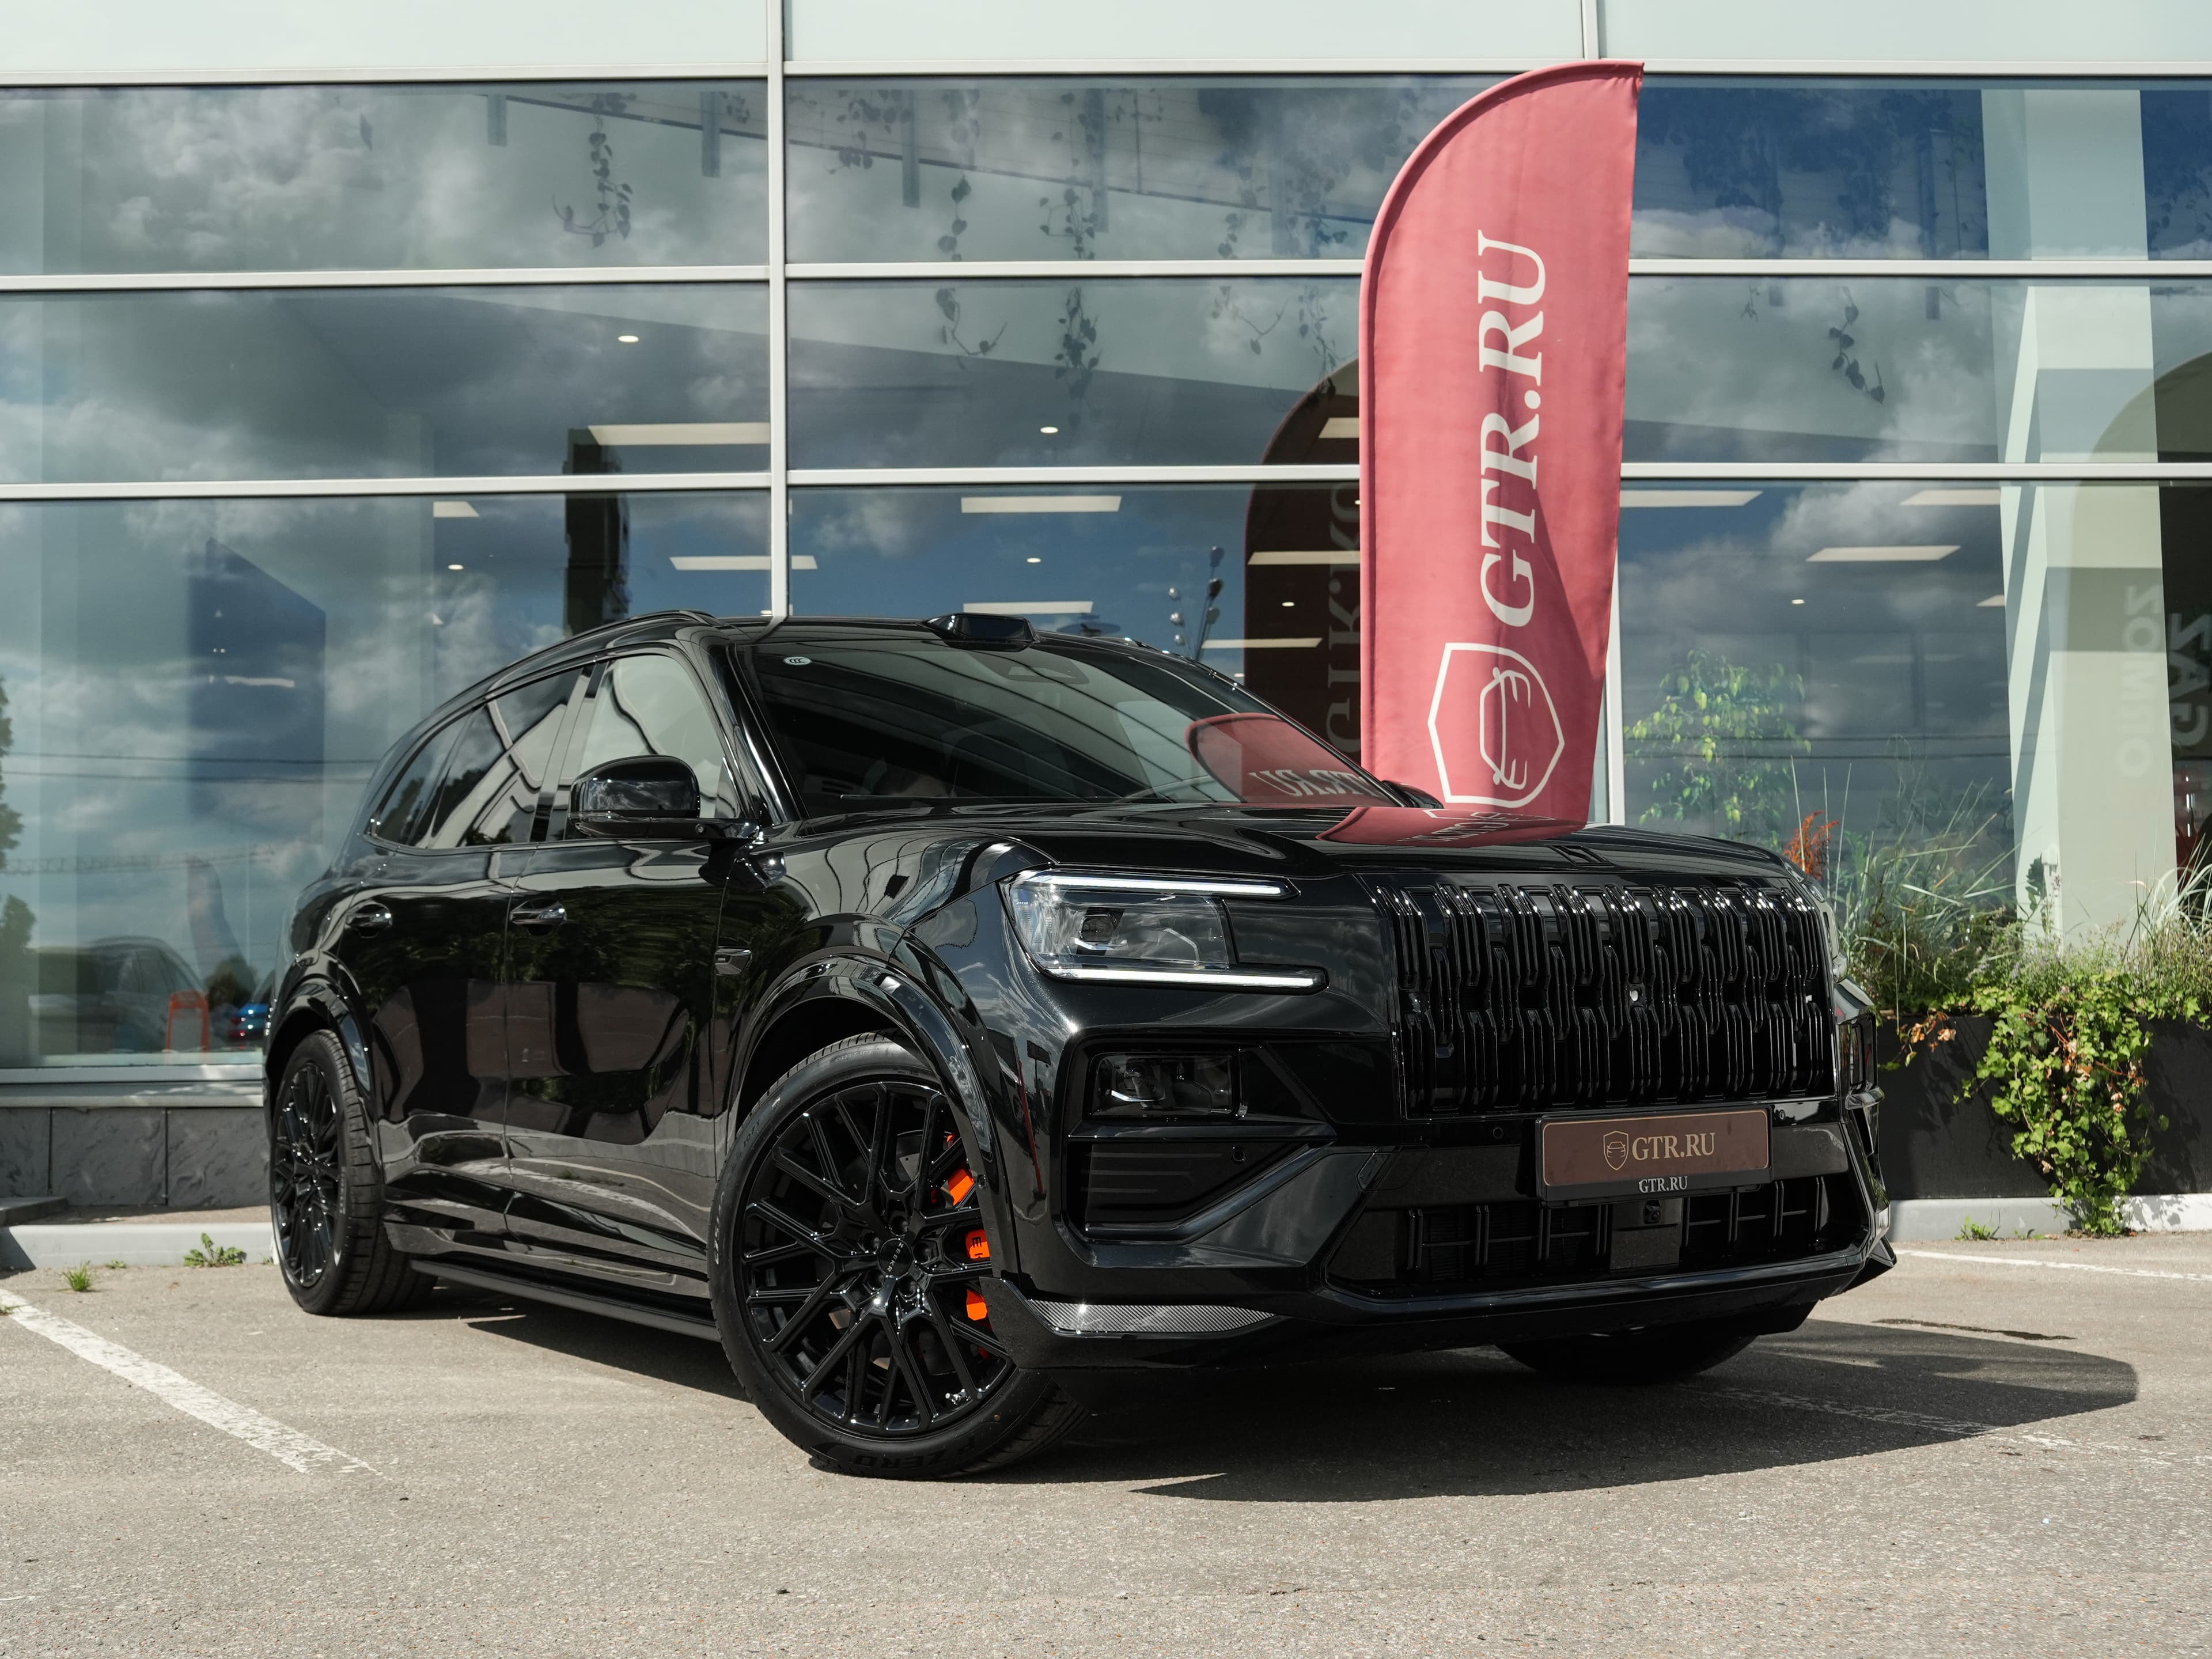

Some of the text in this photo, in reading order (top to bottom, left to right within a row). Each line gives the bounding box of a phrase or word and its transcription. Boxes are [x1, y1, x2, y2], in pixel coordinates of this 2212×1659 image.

[1478, 229, 1546, 627] GTR.RU
[1632, 1132, 1716, 1161] GTR.RU
[1638, 1176, 1688, 1193] GTR.RU
[886, 1242, 904, 1272] ZEEKR
[853, 1449, 948, 1469] ZERO
